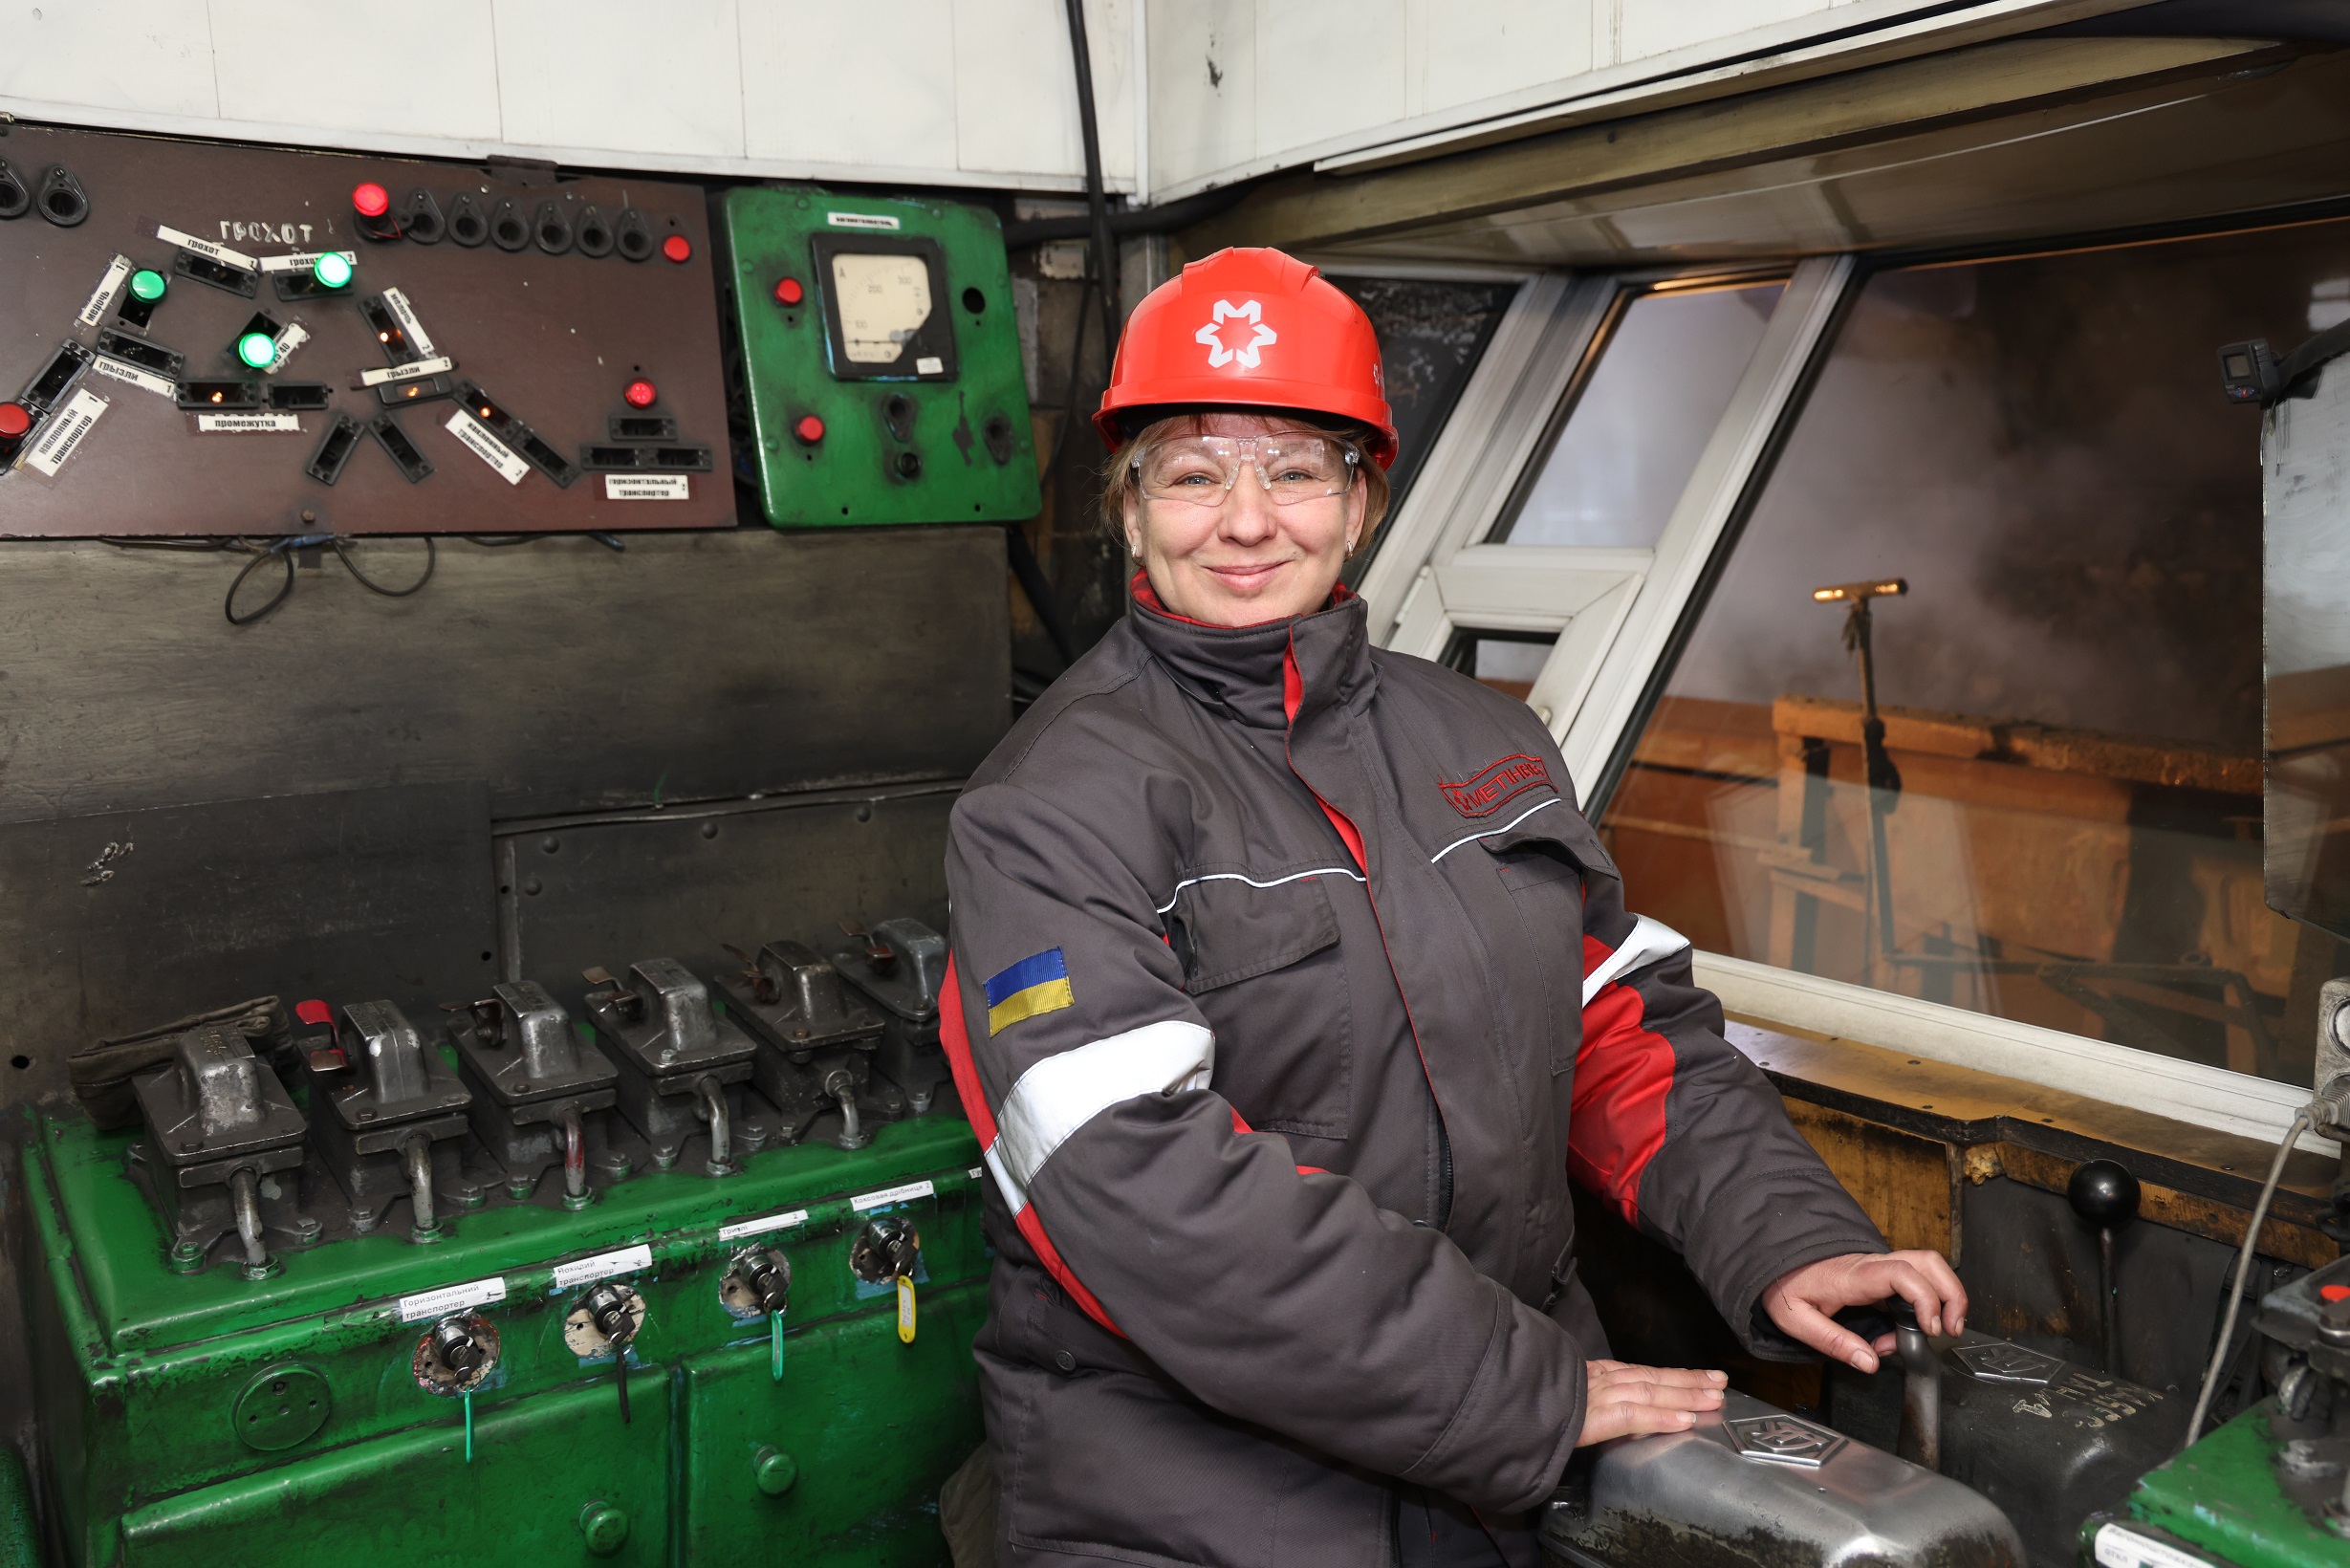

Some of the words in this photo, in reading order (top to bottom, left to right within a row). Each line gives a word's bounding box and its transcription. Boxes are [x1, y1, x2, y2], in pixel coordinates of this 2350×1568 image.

[219, 220, 314, 244] ГРОХОТ
[187, 239, 221, 255] грохот
[249, 260, 255, 269] 1
[290, 256, 320, 267] грохо
[347, 253, 353, 262] 2
[86, 291, 110, 322] мелочь
[116, 263, 125, 272] 1
[98, 360, 140, 381] грызли
[166, 384, 172, 393] 1
[386, 366, 421, 380] грызли
[88, 395, 98, 403] 1
[38, 408, 78, 456] наклонный
[214, 419, 276, 428] промежутка
[50, 415, 94, 465] транспортер
[854, 1192, 888, 1205] Коксовая
[559, 1268, 615, 1286] транспортер
[403, 1284, 480, 1308] Горизонтальний
[405, 1299, 466, 1319] транспортер
